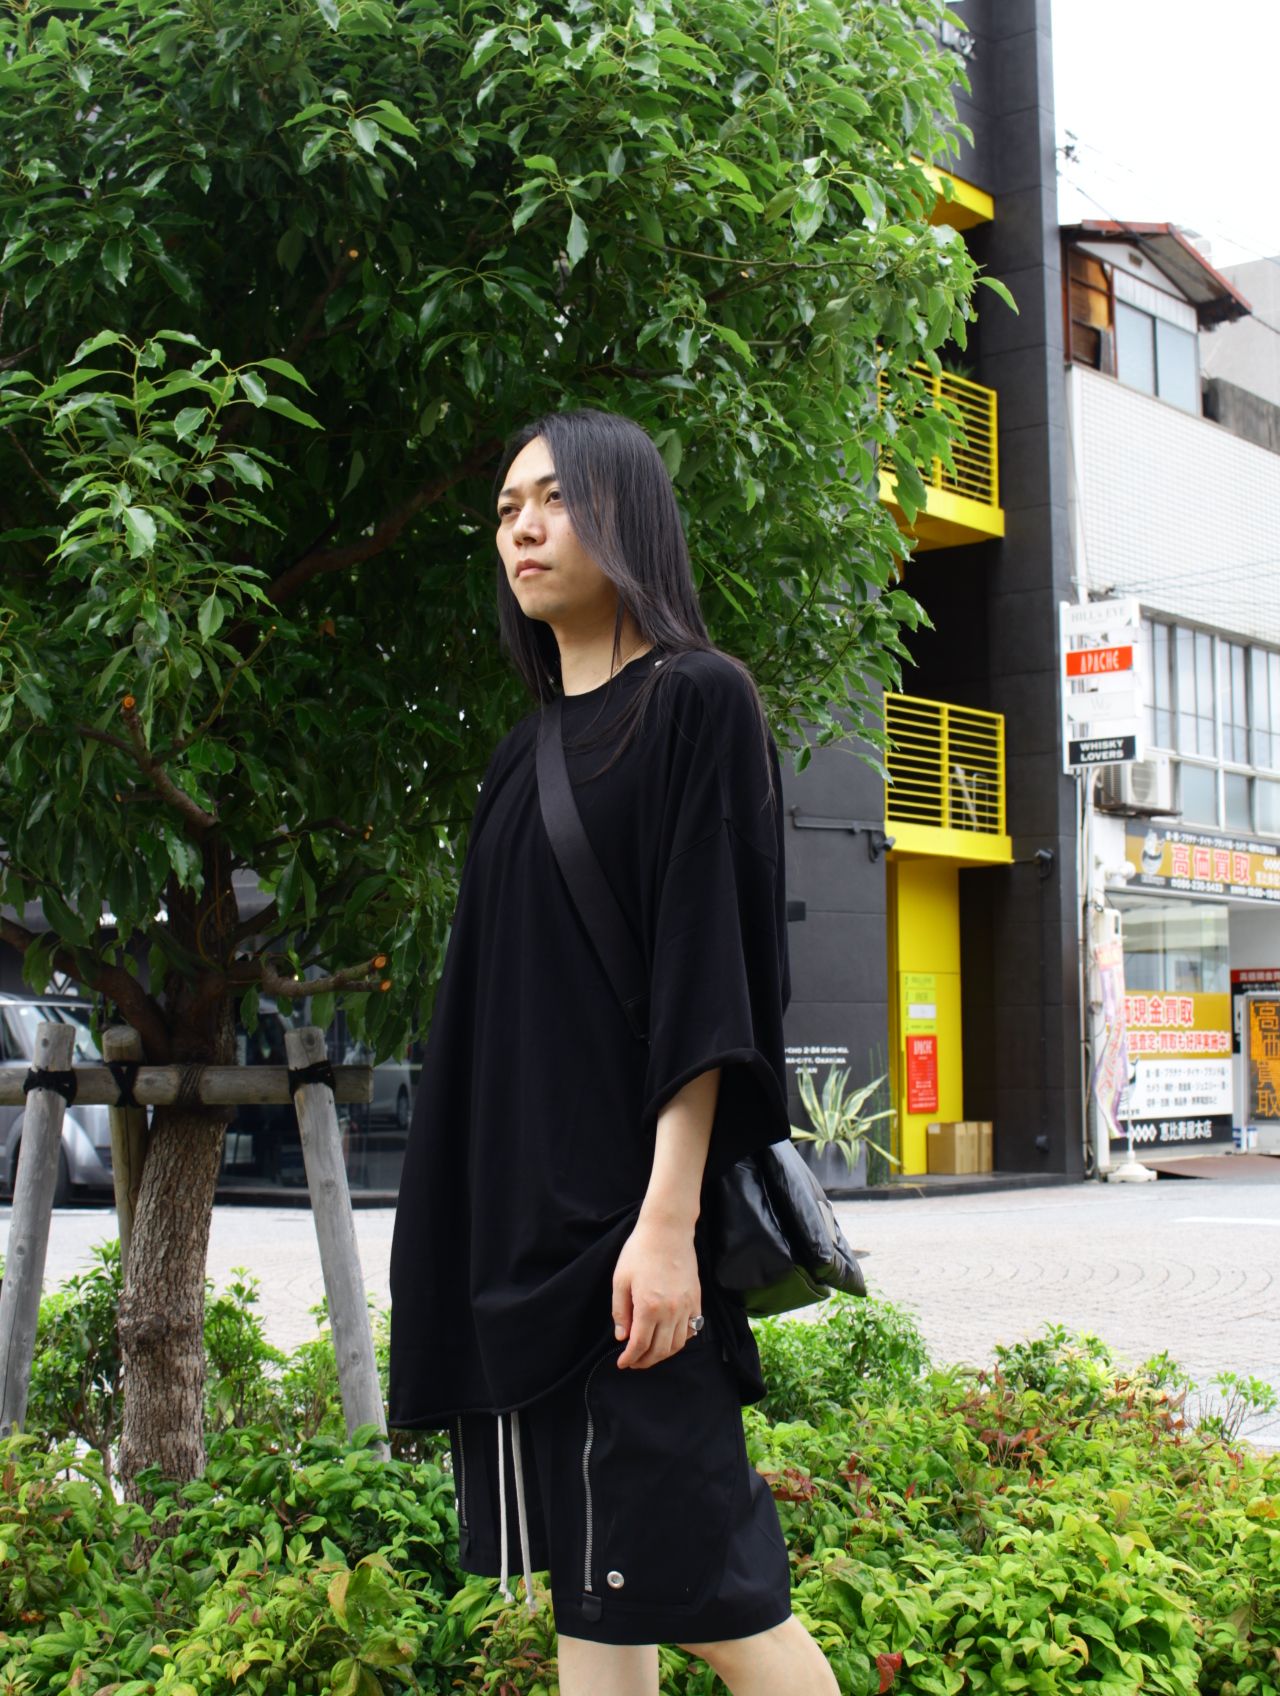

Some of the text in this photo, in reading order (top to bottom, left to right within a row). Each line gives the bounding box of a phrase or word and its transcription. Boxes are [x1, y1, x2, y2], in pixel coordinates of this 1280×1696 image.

[1080, 649, 1119, 673] APACHE
[1079, 739, 1124, 751] WHISKY
[1080, 749, 1124, 762] LOVERS
[1172, 844, 1250, 883] 高価買取
